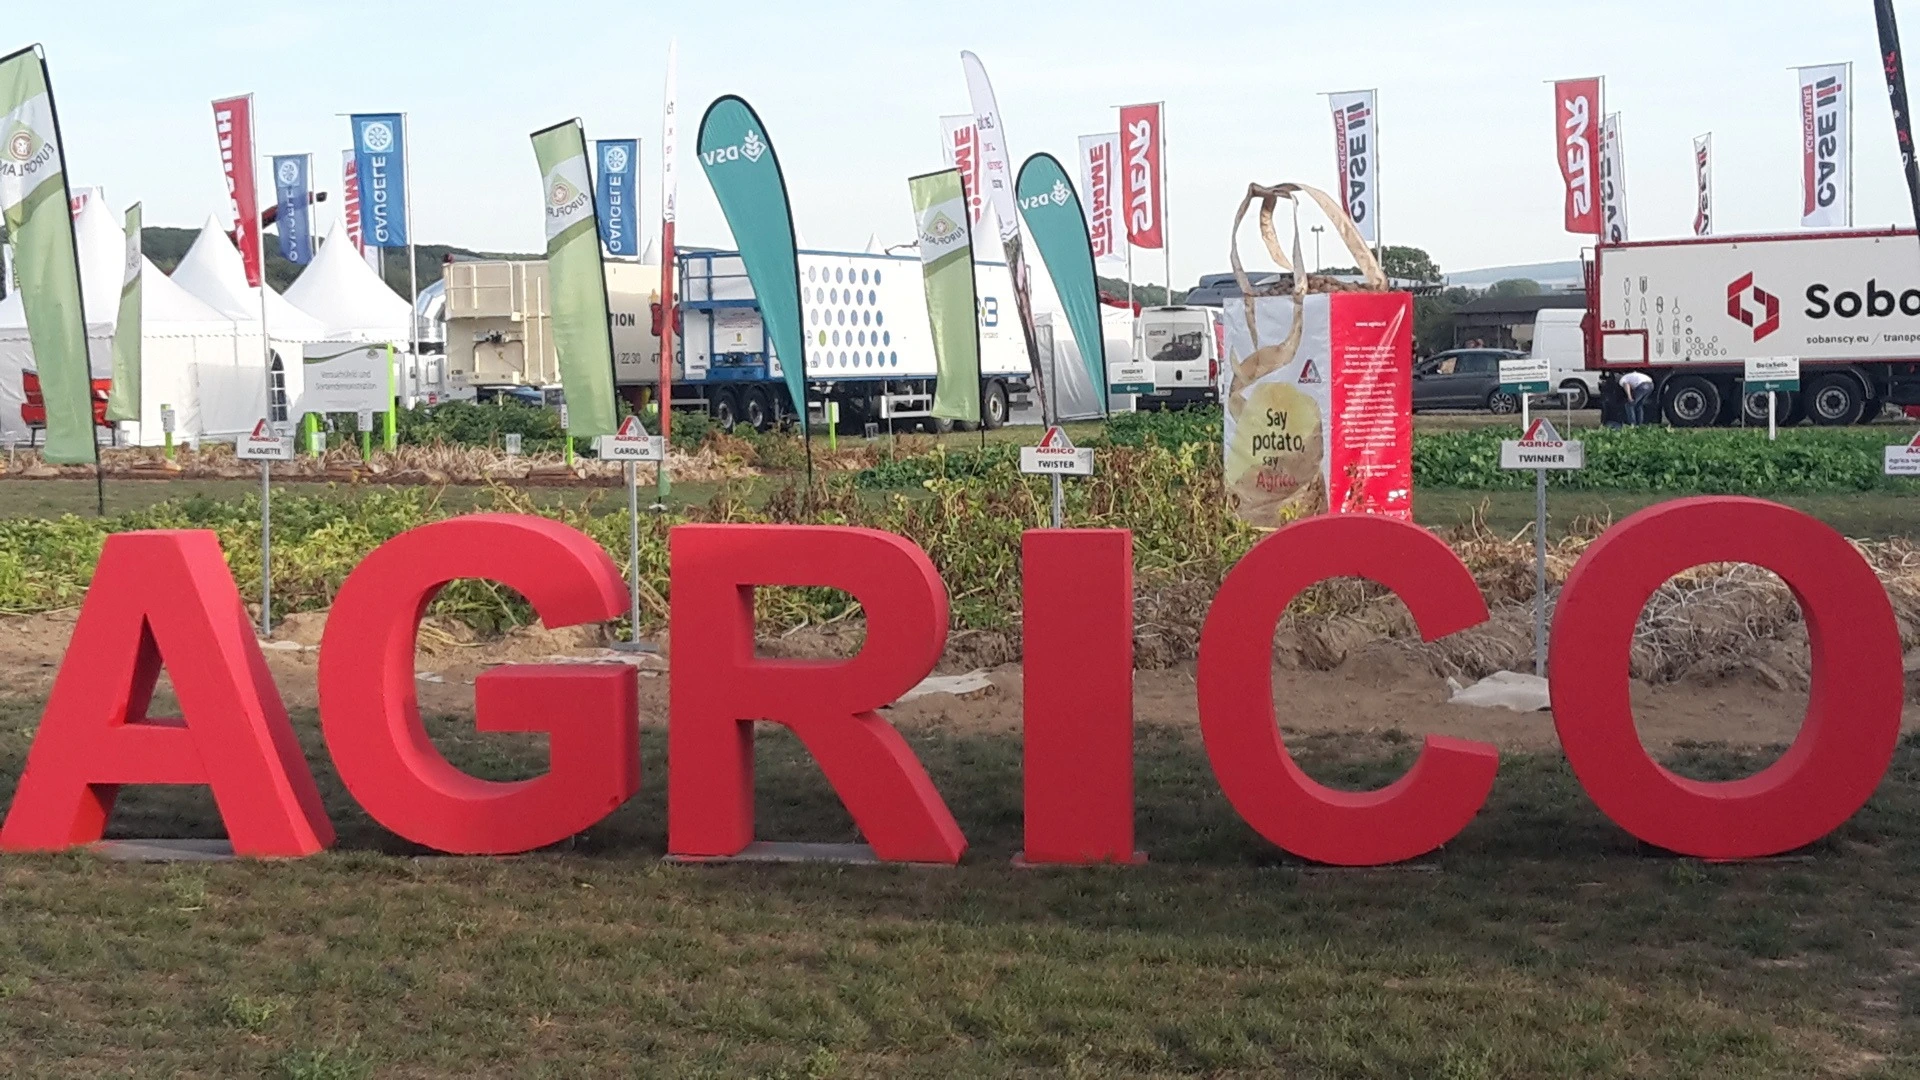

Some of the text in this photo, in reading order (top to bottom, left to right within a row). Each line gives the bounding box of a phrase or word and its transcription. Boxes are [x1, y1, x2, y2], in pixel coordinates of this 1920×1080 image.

[1806, 334, 1869, 345] sobanscy.eu
[1266, 407, 1287, 430] Say
[1252, 431, 1305, 456] potato,
[614, 447, 650, 456] CAROLUS
[1038, 460, 1075, 468] TWISTER
[1262, 455, 1279, 470] say
[1518, 454, 1565, 463] TWINNER
[0, 495, 1903, 867] AGRICO
